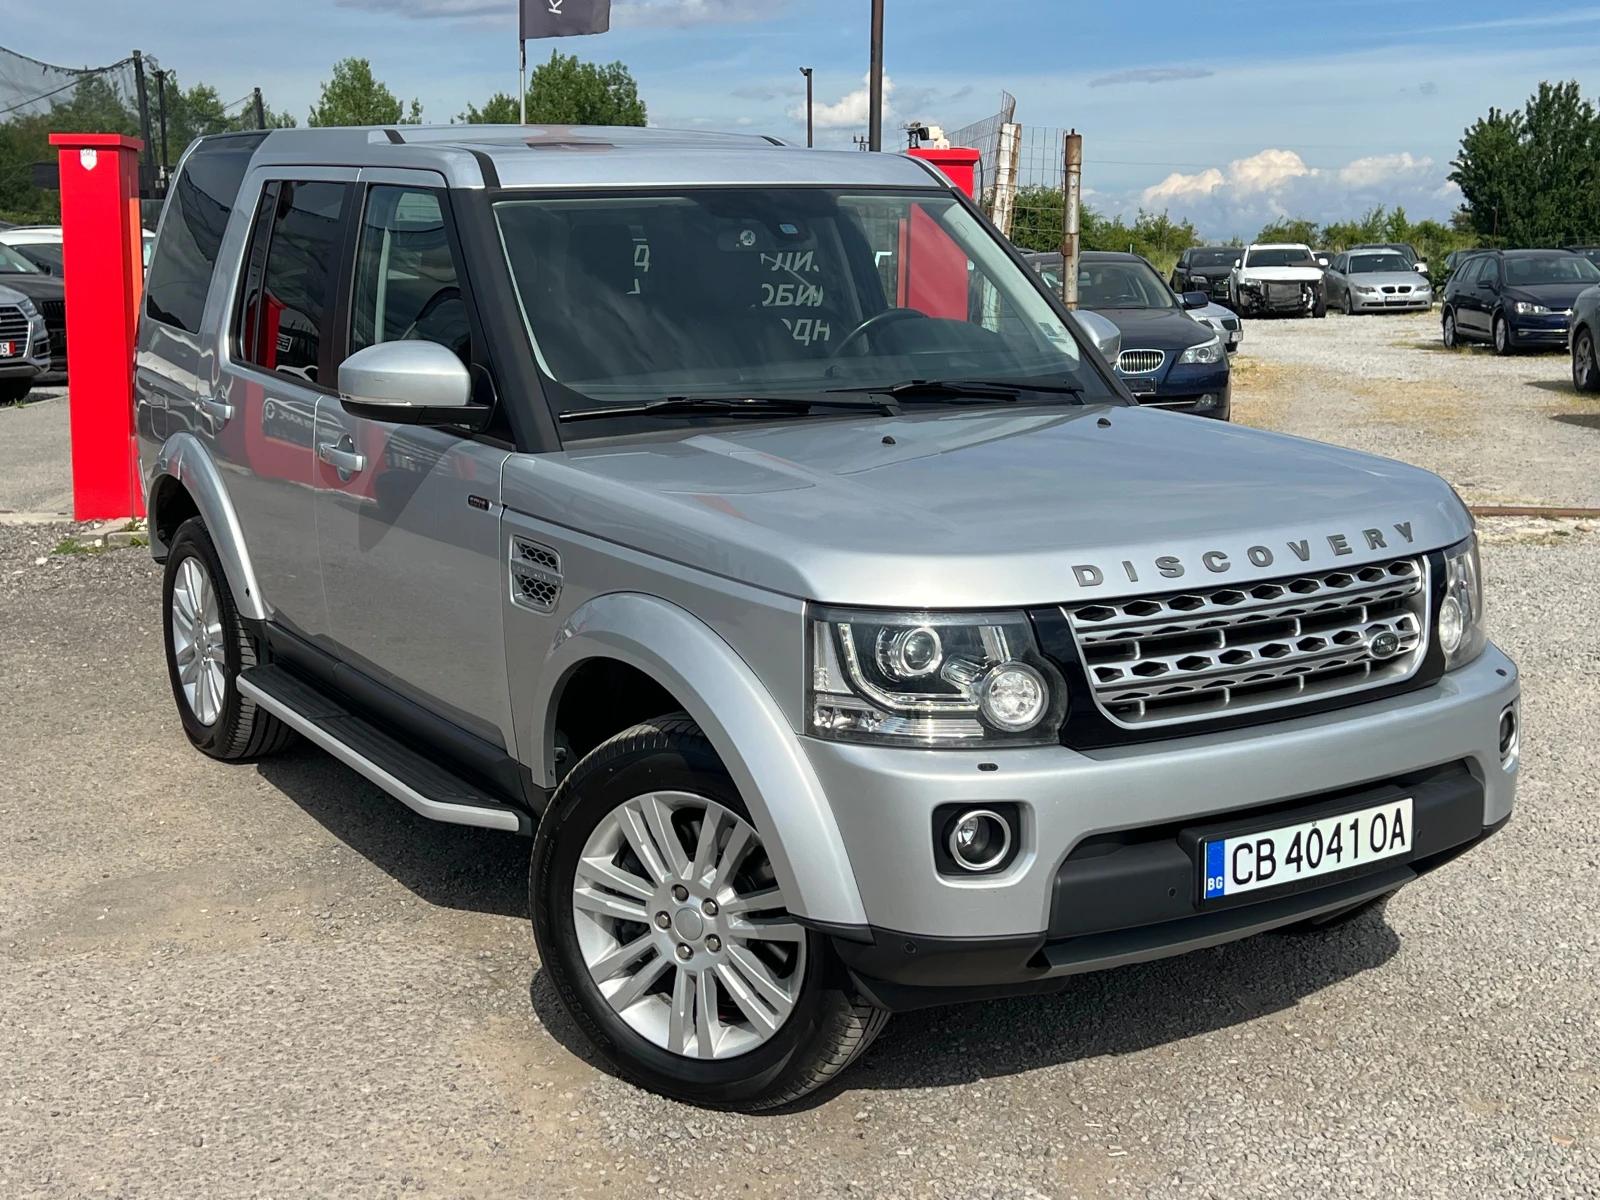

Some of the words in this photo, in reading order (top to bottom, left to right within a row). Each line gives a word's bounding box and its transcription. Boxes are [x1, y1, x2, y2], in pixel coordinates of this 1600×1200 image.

[1071, 522, 1415, 587] DISCOVERY
[1232, 838, 1277, 885] CB
[1285, 818, 1360, 873] 4041
[1369, 808, 1406, 853] OA
[1207, 877, 1224, 891] BG
